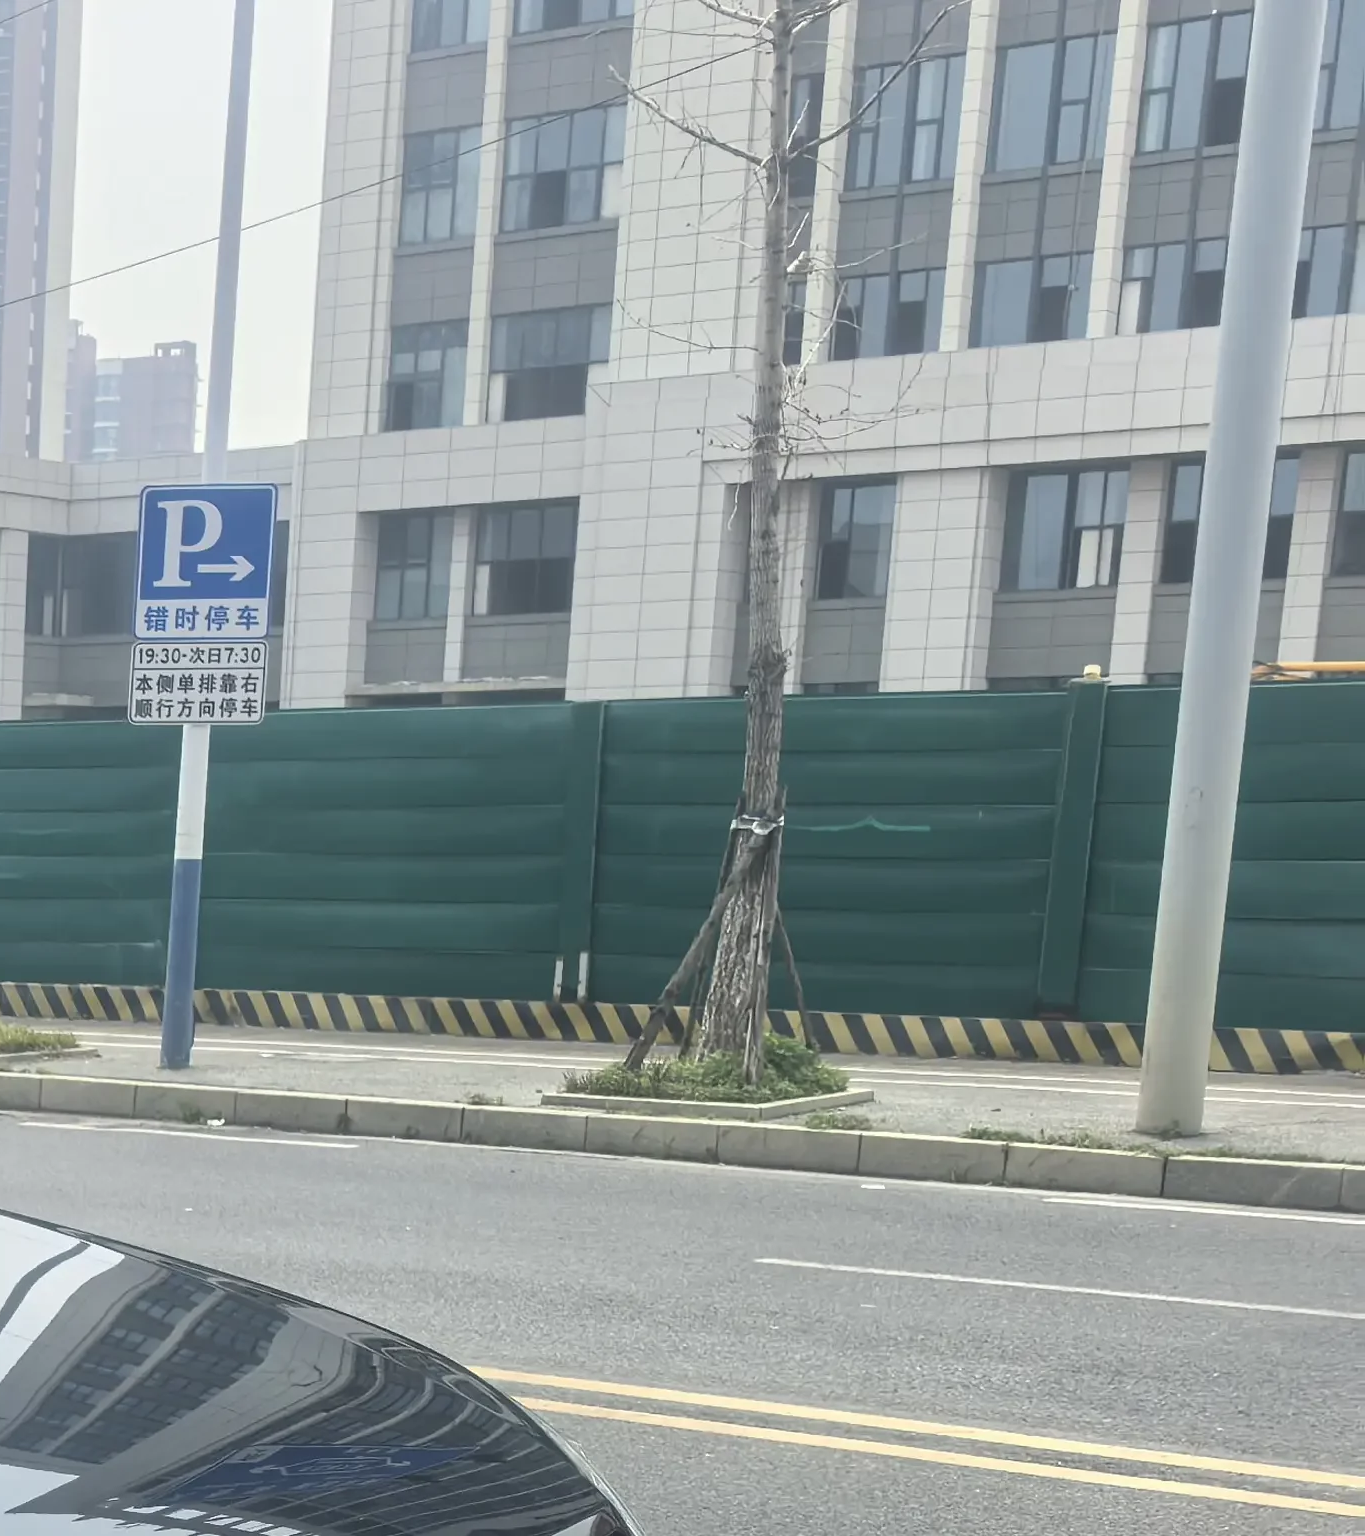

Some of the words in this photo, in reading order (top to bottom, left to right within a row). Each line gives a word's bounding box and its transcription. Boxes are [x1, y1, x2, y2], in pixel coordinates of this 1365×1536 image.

[152, 499, 223, 588] P
[143, 605, 260, 633] 错时停车
[135, 673, 260, 695] 本侧单排靠右
[134, 697, 260, 720] 顺行方向停车
